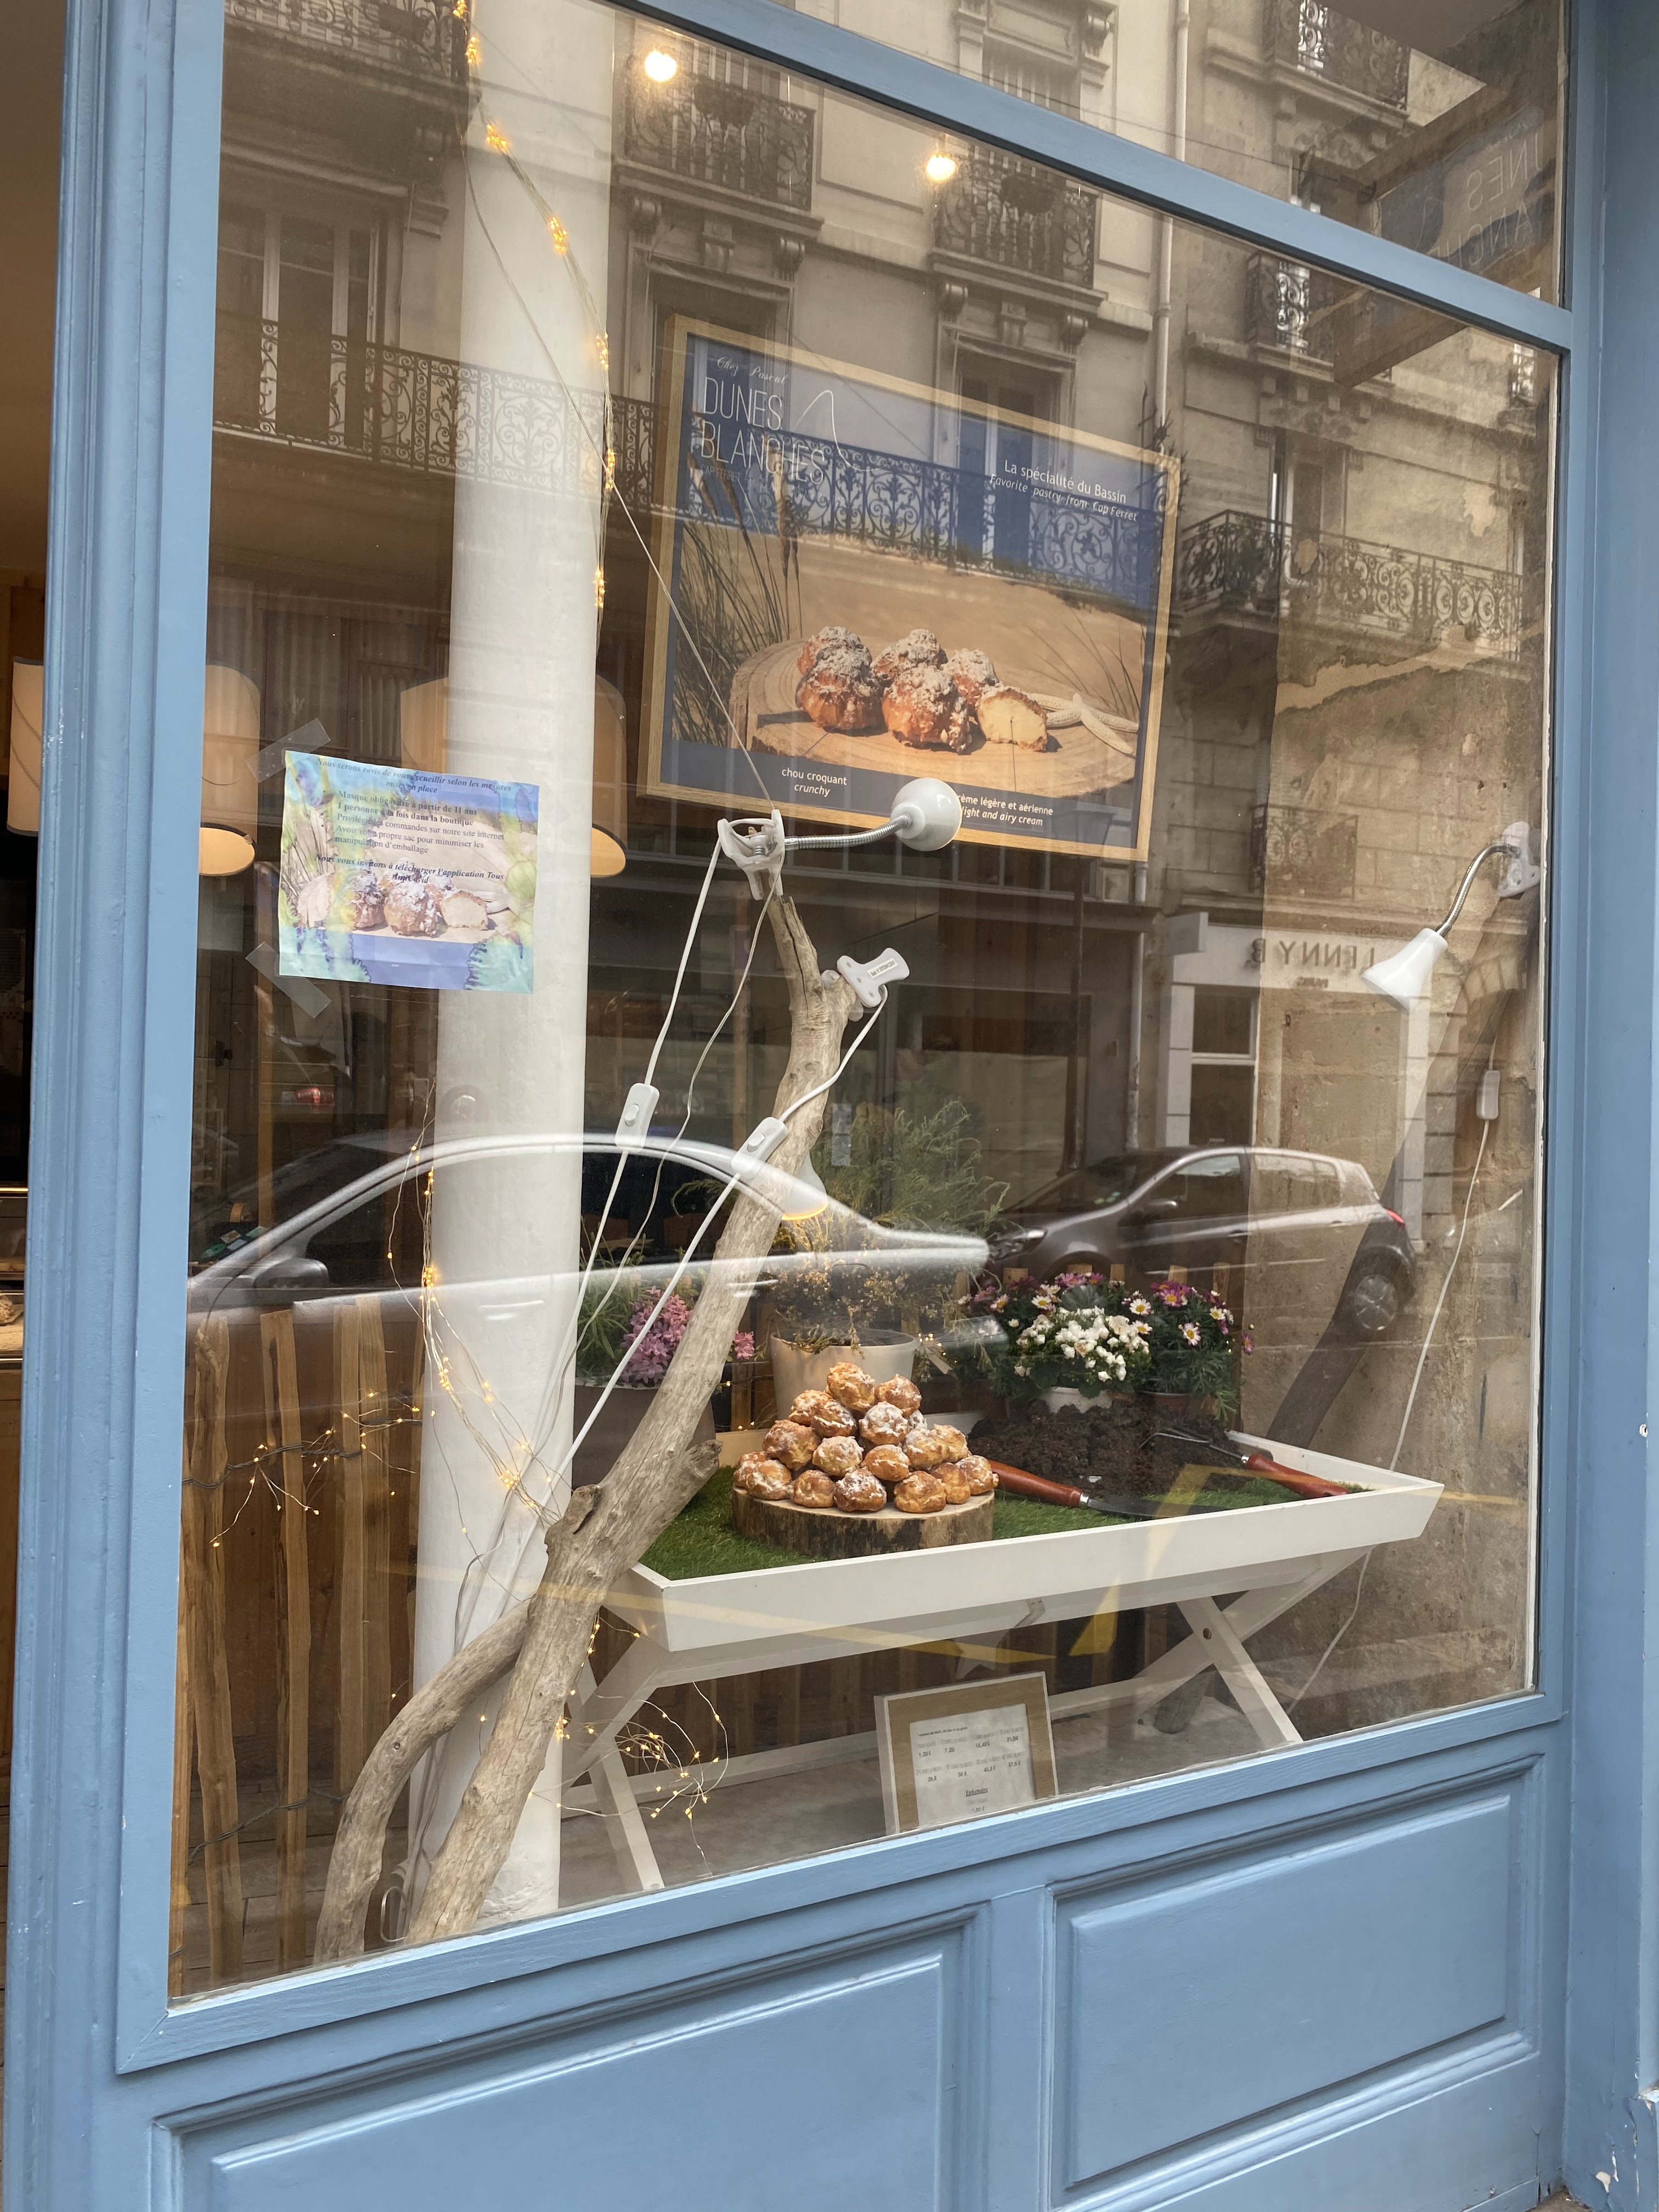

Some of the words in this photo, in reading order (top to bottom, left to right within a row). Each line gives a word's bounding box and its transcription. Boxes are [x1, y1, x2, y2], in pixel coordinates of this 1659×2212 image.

[716, 357, 738, 376] Chez
[749, 366, 788, 384] Pascal
[703, 376, 782, 430] DUNES
[701, 420, 825, 485] BLANCHES
[716, 469, 741, 482] FERRET
[1005, 459, 1017, 475] La
[1020, 466, 1074, 490] spécialité
[1077, 480, 1091, 494] du
[1094, 484, 1126, 504] Bassin
[990, 474, 1028, 493] Favorite
[1033, 487, 1062, 504] pastry
[1065, 494, 1088, 508] from
[1093, 501, 1109, 515] Cap
[1110, 506, 1137, 522] Ferret
[316, 758, 336, 768] Nous
[337, 762, 361, 772] serons
[363, 766, 381, 775] ravis
[447, 778, 467, 787] selon
[481, 783, 511, 792] mesures
[782, 768, 804, 779] chou
[806, 772, 848, 786] croquant
[417, 785, 438, 793] place
[794, 783, 831, 798] crunchy
[337, 791, 368, 802] Masque
[418, 803, 440, 811] partir
[958, 793, 978, 805] rème
[980, 796, 1006, 809] légère
[1008, 802, 1017, 811] et
[1019, 803, 1053, 816] aérienne
[344, 803, 379, 814] personne
[396, 810, 409, 819] fois
[411, 813, 428, 821] dans
[440, 816, 473, 827] boutique
[982, 811, 998, 820] and
[1000, 812, 1017, 824] airy
[1018, 815, 1043, 826] cream
[336, 825, 357, 833] Avoir
[379, 832, 402, 840] propre
[436, 838, 472, 848] minimiser
[385, 821, 427, 832] commandes
[477, 830, 505, 840] internet
[335, 836, 383, 848] manipulation
[385, 841, 428, 855] d'emballage
[315, 853, 335, 863] Nous
[357, 859, 386, 869] invitons
[395, 863, 437, 875] télécharger
[438, 867, 484, 878] l'application
